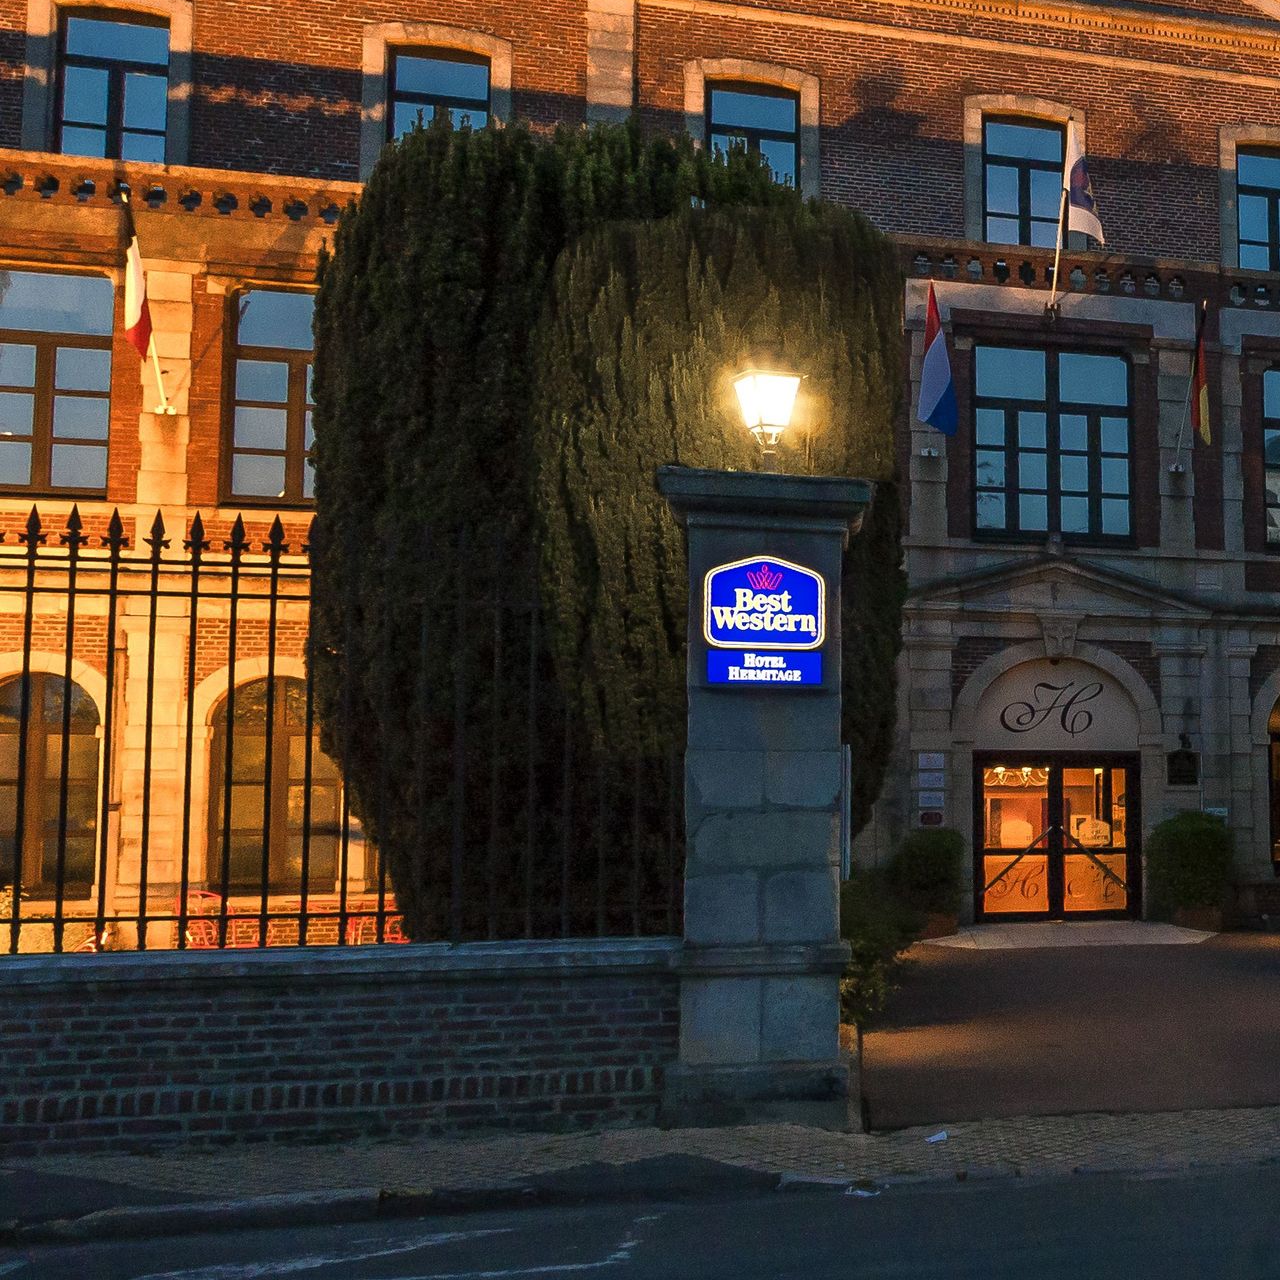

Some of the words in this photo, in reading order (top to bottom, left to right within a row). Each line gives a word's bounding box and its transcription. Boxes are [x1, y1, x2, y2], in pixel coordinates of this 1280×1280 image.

[733, 587, 793, 613] Best
[711, 606, 817, 633] Western
[728, 666, 802, 682] HERMITAGE
[744, 653, 787, 669] HOTEL
[1000, 681, 1104, 738] H
